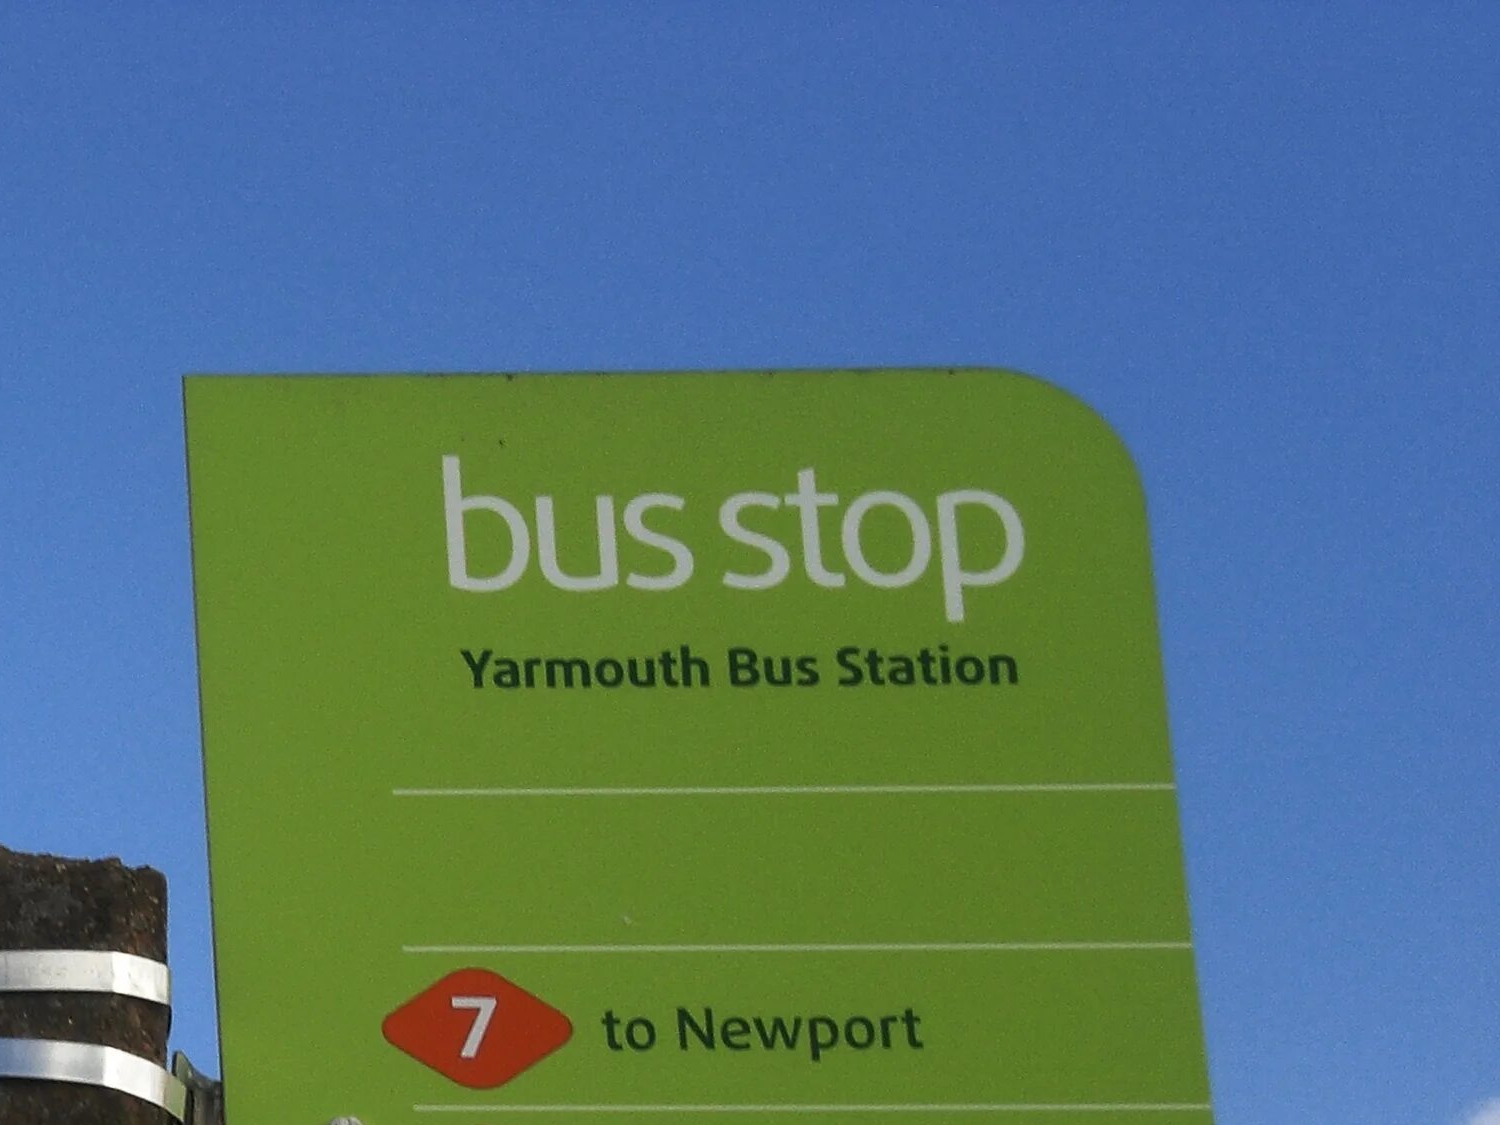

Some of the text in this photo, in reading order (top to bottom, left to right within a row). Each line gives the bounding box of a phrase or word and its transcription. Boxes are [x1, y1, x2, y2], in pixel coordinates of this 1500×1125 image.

[442, 454, 1026, 623] bus stop
[461, 645, 1019, 689] Yarmouth Bus Station
[450, 996, 924, 1062] 7 to Newport
